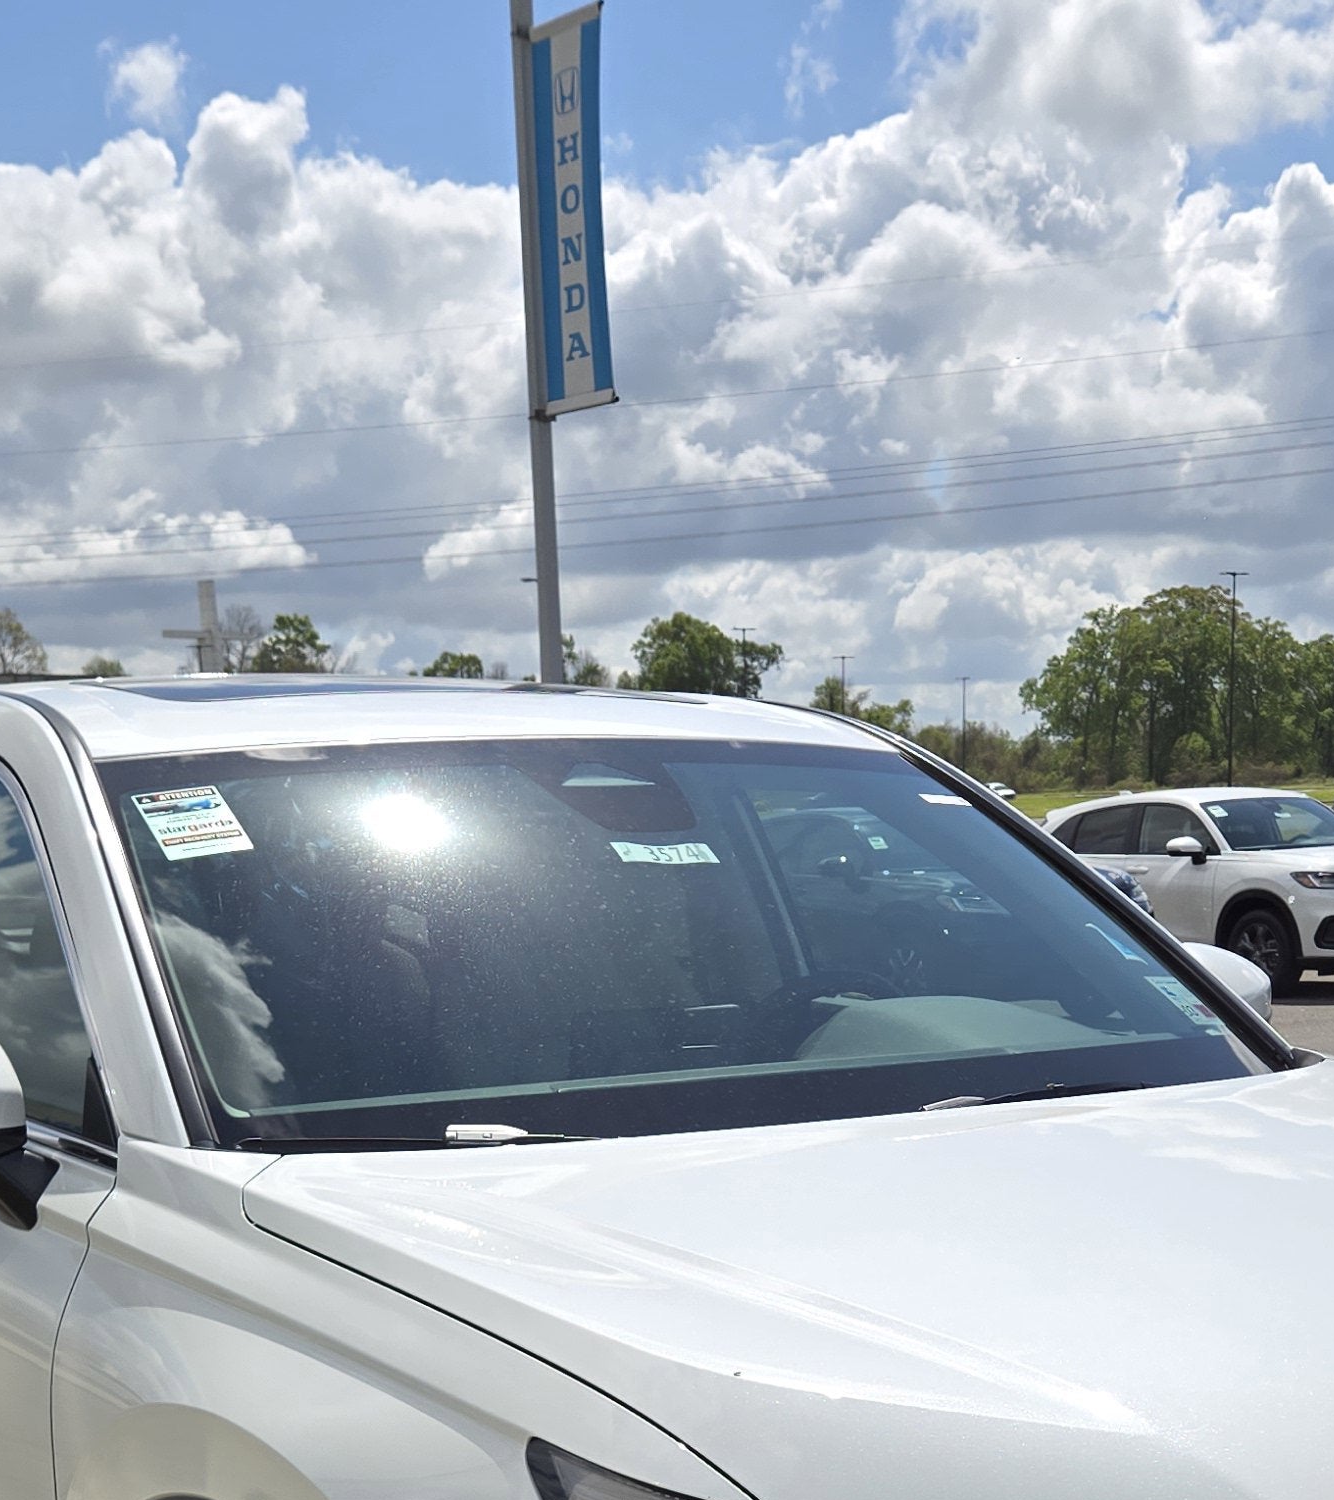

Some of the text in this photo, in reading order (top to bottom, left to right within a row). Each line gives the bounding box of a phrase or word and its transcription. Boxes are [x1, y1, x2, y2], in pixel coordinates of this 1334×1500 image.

[557, 132, 590, 362] HONDA
[158, 788, 214, 801] ATTENTION
[643, 845, 701, 863] 3574
